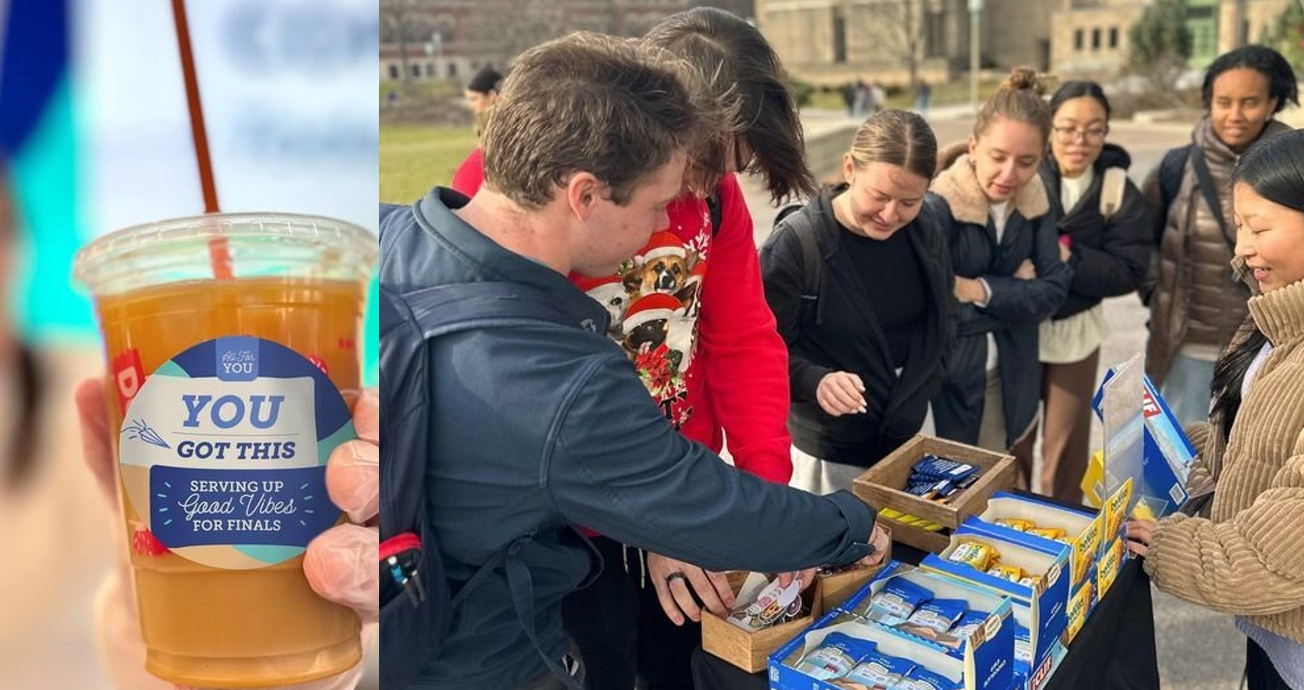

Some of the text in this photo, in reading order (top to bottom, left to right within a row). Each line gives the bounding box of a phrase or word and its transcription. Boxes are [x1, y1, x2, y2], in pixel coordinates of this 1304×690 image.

[222, 362, 253, 374] YOU
[182, 394, 285, 430] YOU
[177, 440, 296, 460] GOT THIS
[190, 480, 284, 493] SERVING UP
[178, 493, 297, 521] Good Vibes
[193, 519, 282, 532] FOR FINALS
